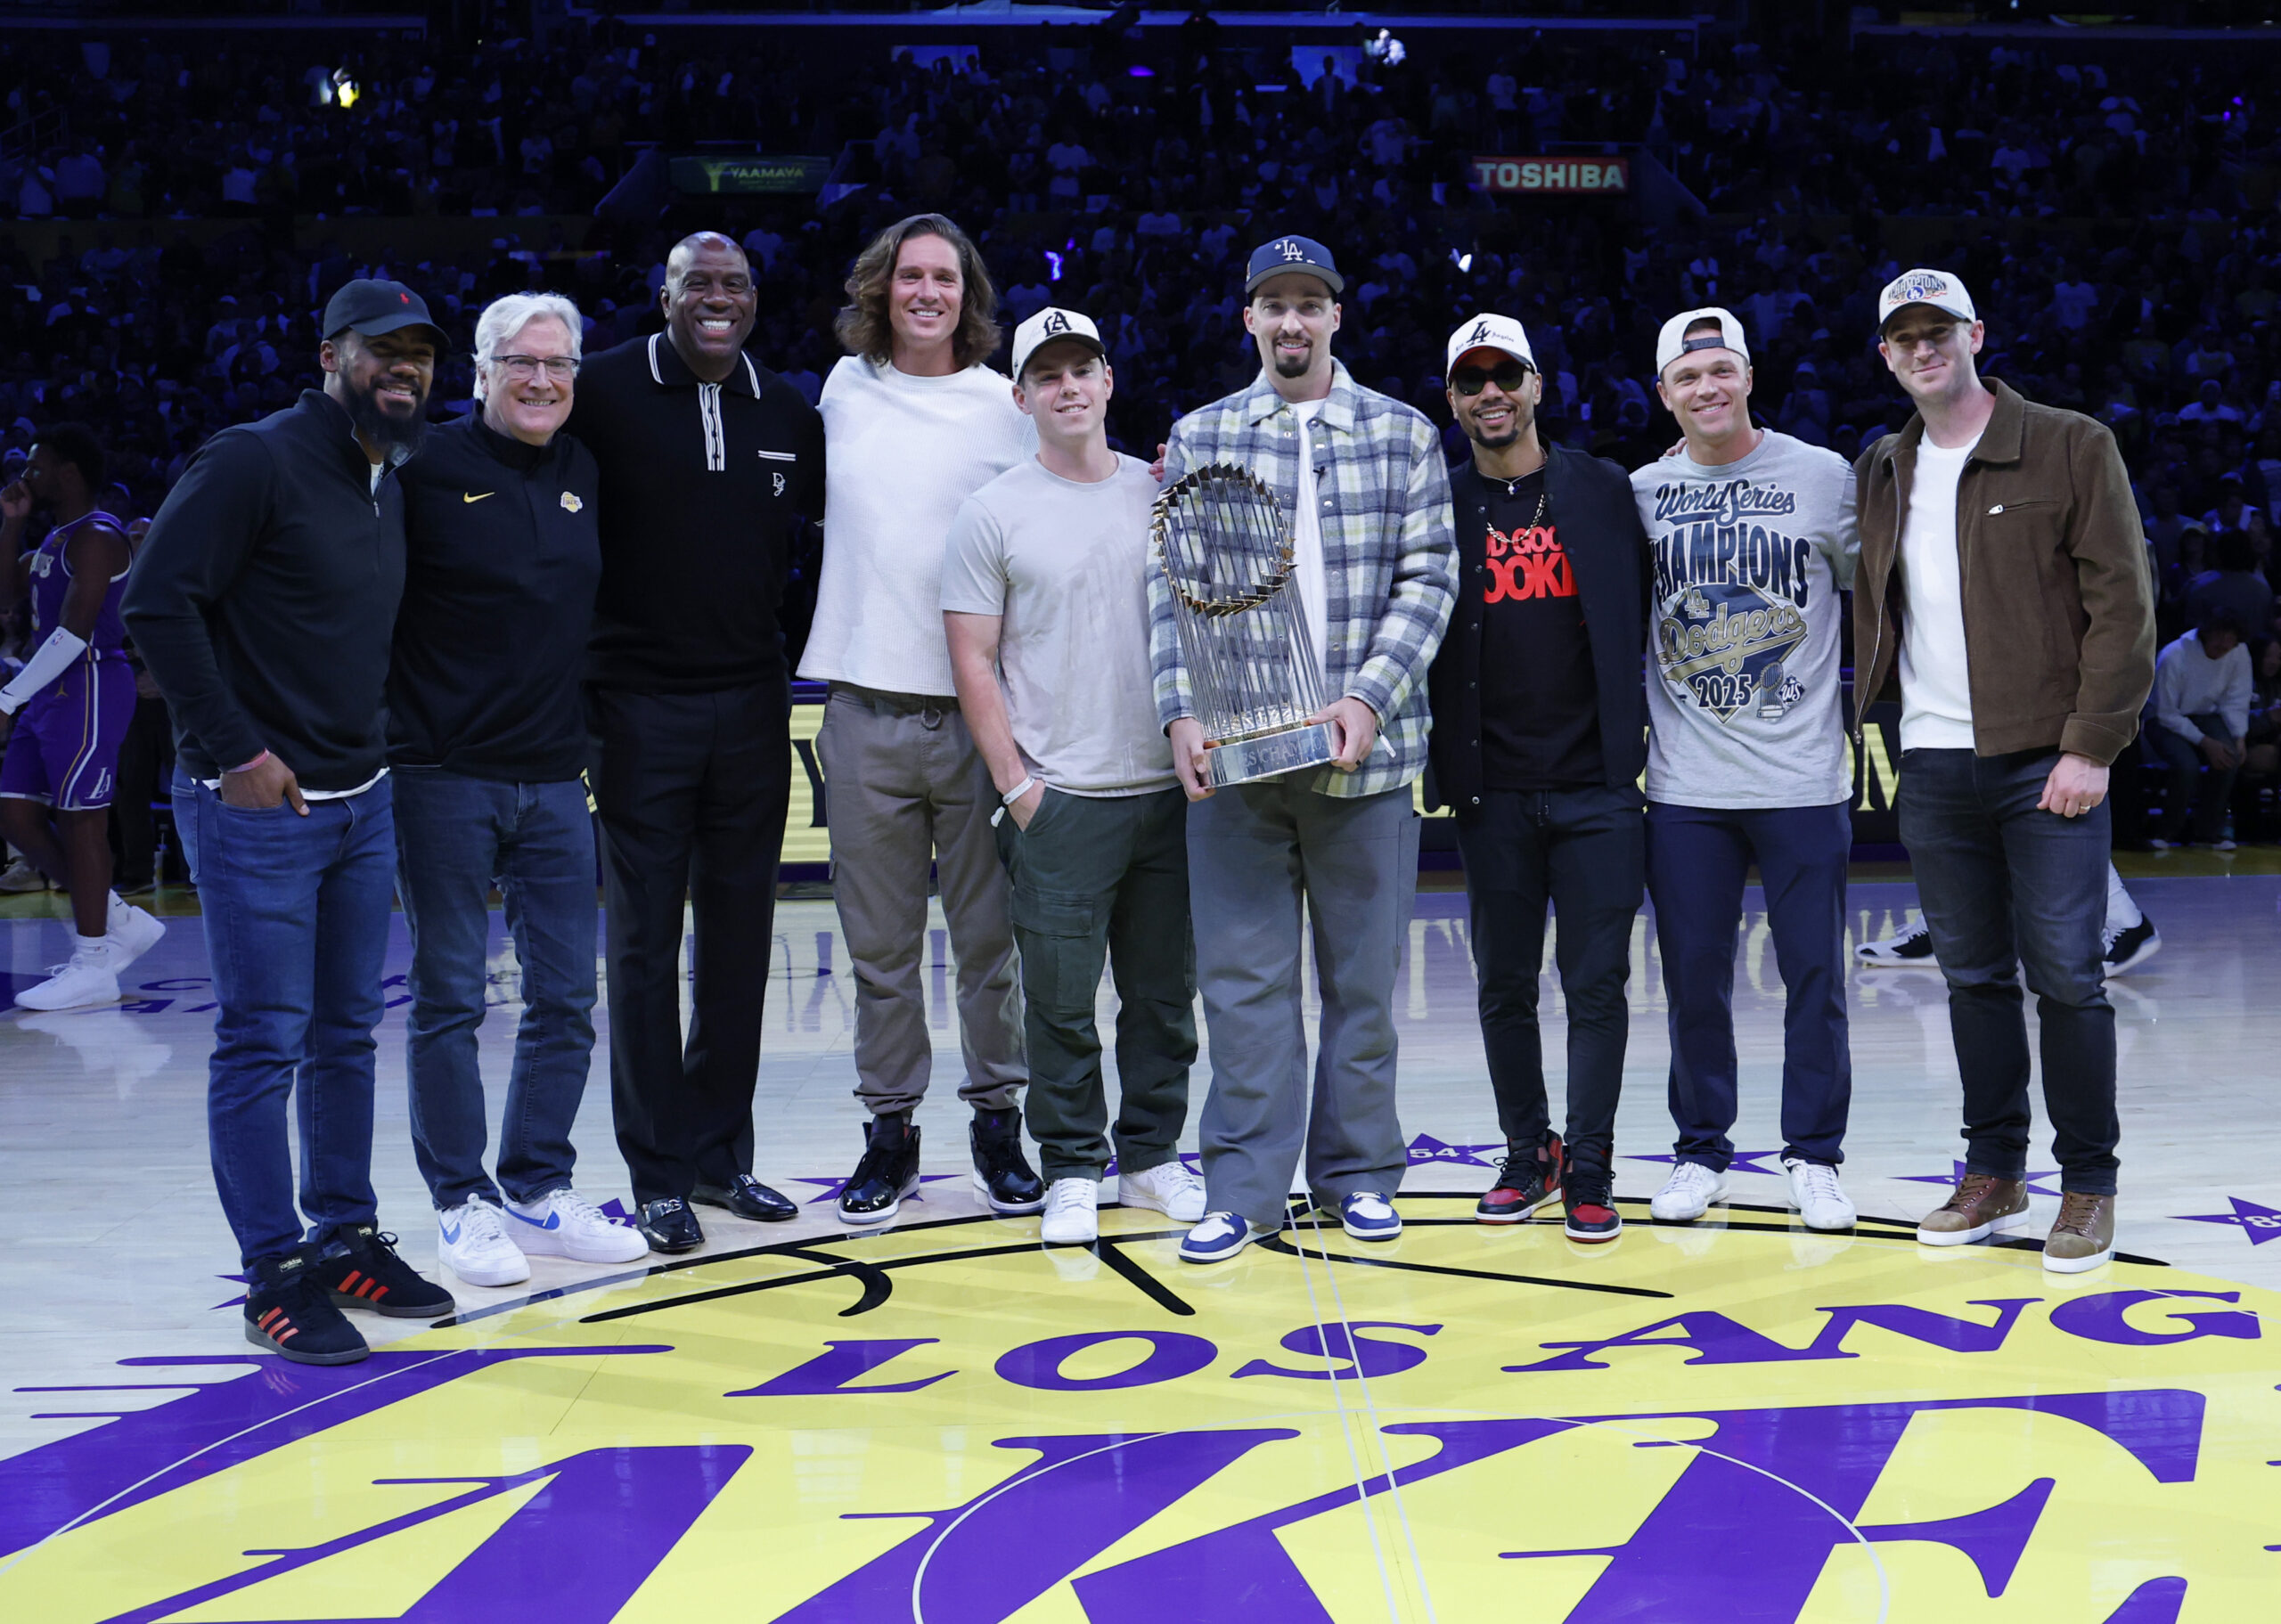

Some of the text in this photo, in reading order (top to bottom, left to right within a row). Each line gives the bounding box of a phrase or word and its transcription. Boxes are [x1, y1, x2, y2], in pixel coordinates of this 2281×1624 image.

[1476, 162, 1625, 189] TOSHIBA
[1281, 239, 1304, 261] LA
[1655, 477, 1795, 526] World Series
[1684, 582, 1710, 619] LA
[1657, 604, 1808, 674] Dodgers
[1696, 674, 1753, 710] 2025
[1409, 1147, 1460, 1158] 54
[724, 1288, 2262, 1398] LOS ANG
